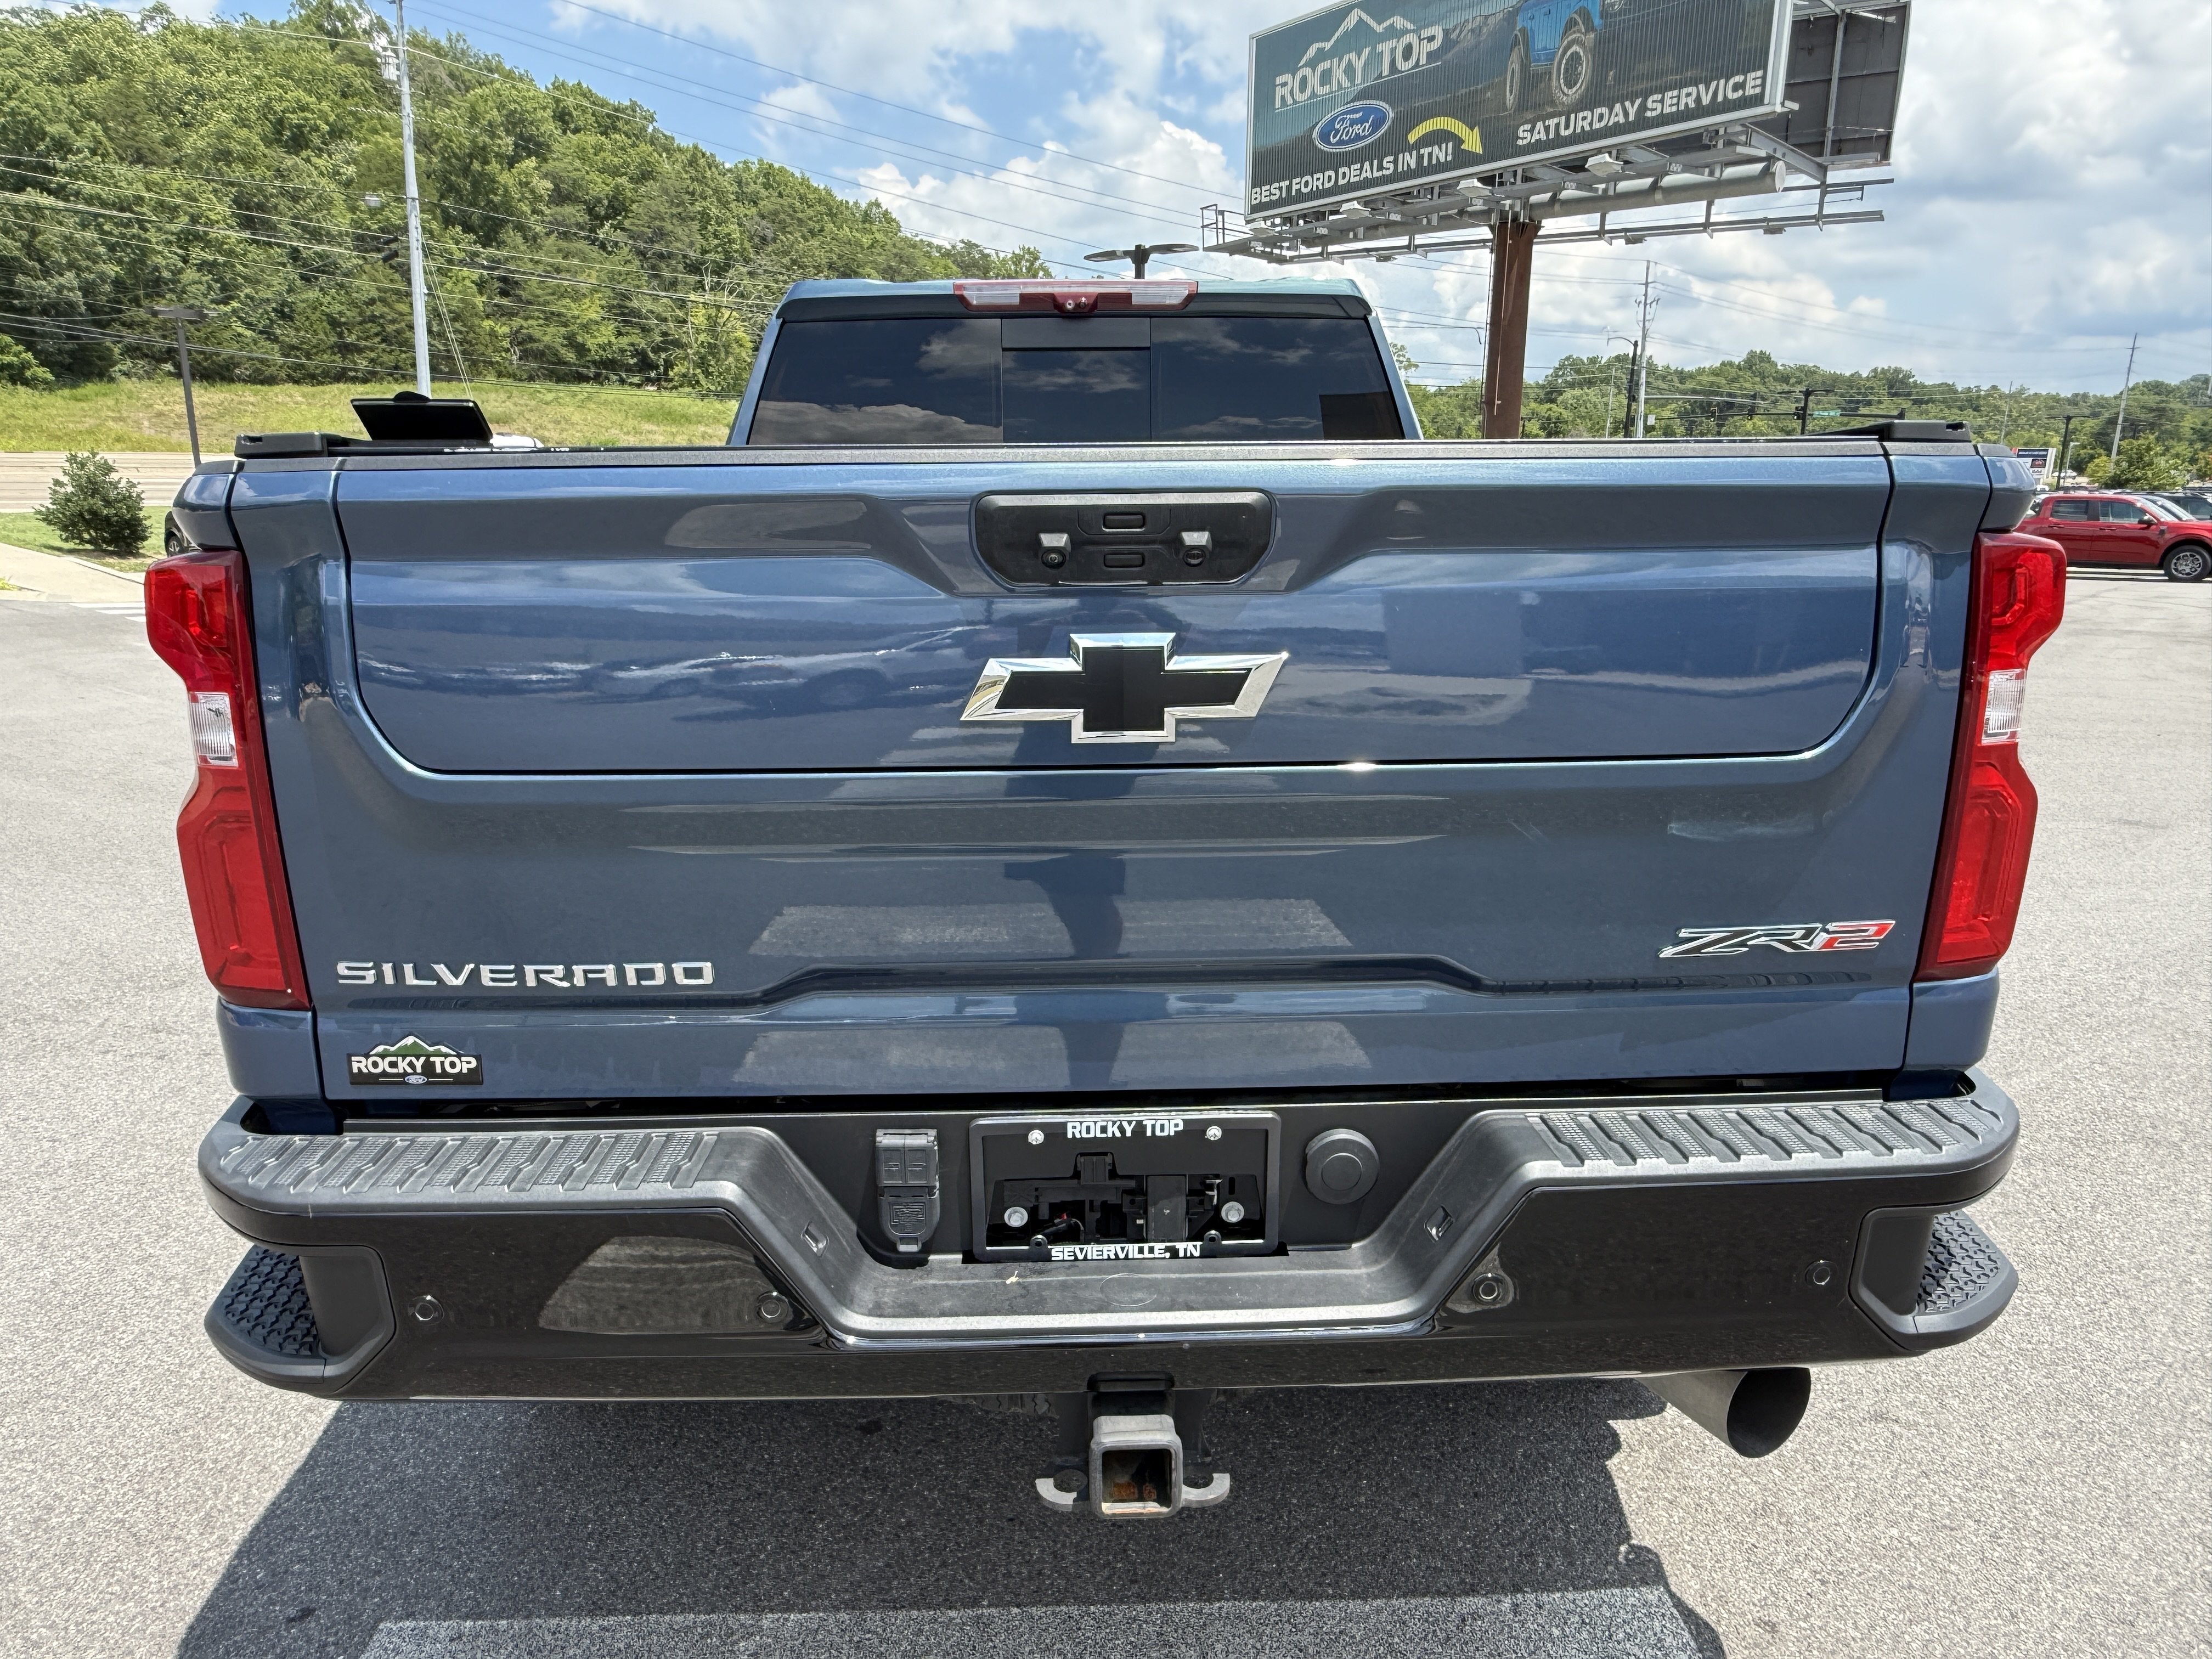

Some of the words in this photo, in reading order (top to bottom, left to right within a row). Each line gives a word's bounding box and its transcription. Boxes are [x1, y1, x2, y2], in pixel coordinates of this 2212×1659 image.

[1275, 46, 1371, 109] ROCKY
[1376, 24, 1444, 77] TOP
[1516, 97, 1643, 146] SATURDAY
[1643, 69, 1764, 117] SERVICE
[1330, 111, 1375, 143] Ford
[1251, 179, 1290, 205] BEST
[1291, 170, 1335, 196] FORD
[1338, 155, 1395, 186] DEALS
[1397, 149, 1417, 173] IN
[1419, 141, 1453, 167] TN!
[1658, 919, 1897, 958] ZR2
[336, 961, 716, 987] SILVERADO
[351, 1056, 426, 1073] ROCKY
[430, 1056, 477, 1074] TOP
[1066, 1120, 1136, 1138] ROCKY
[1143, 1119, 1184, 1136] TOP
[1051, 1245, 1171, 1261] SEVIERVILLE,
[1175, 1243, 1203, 1257] TN
